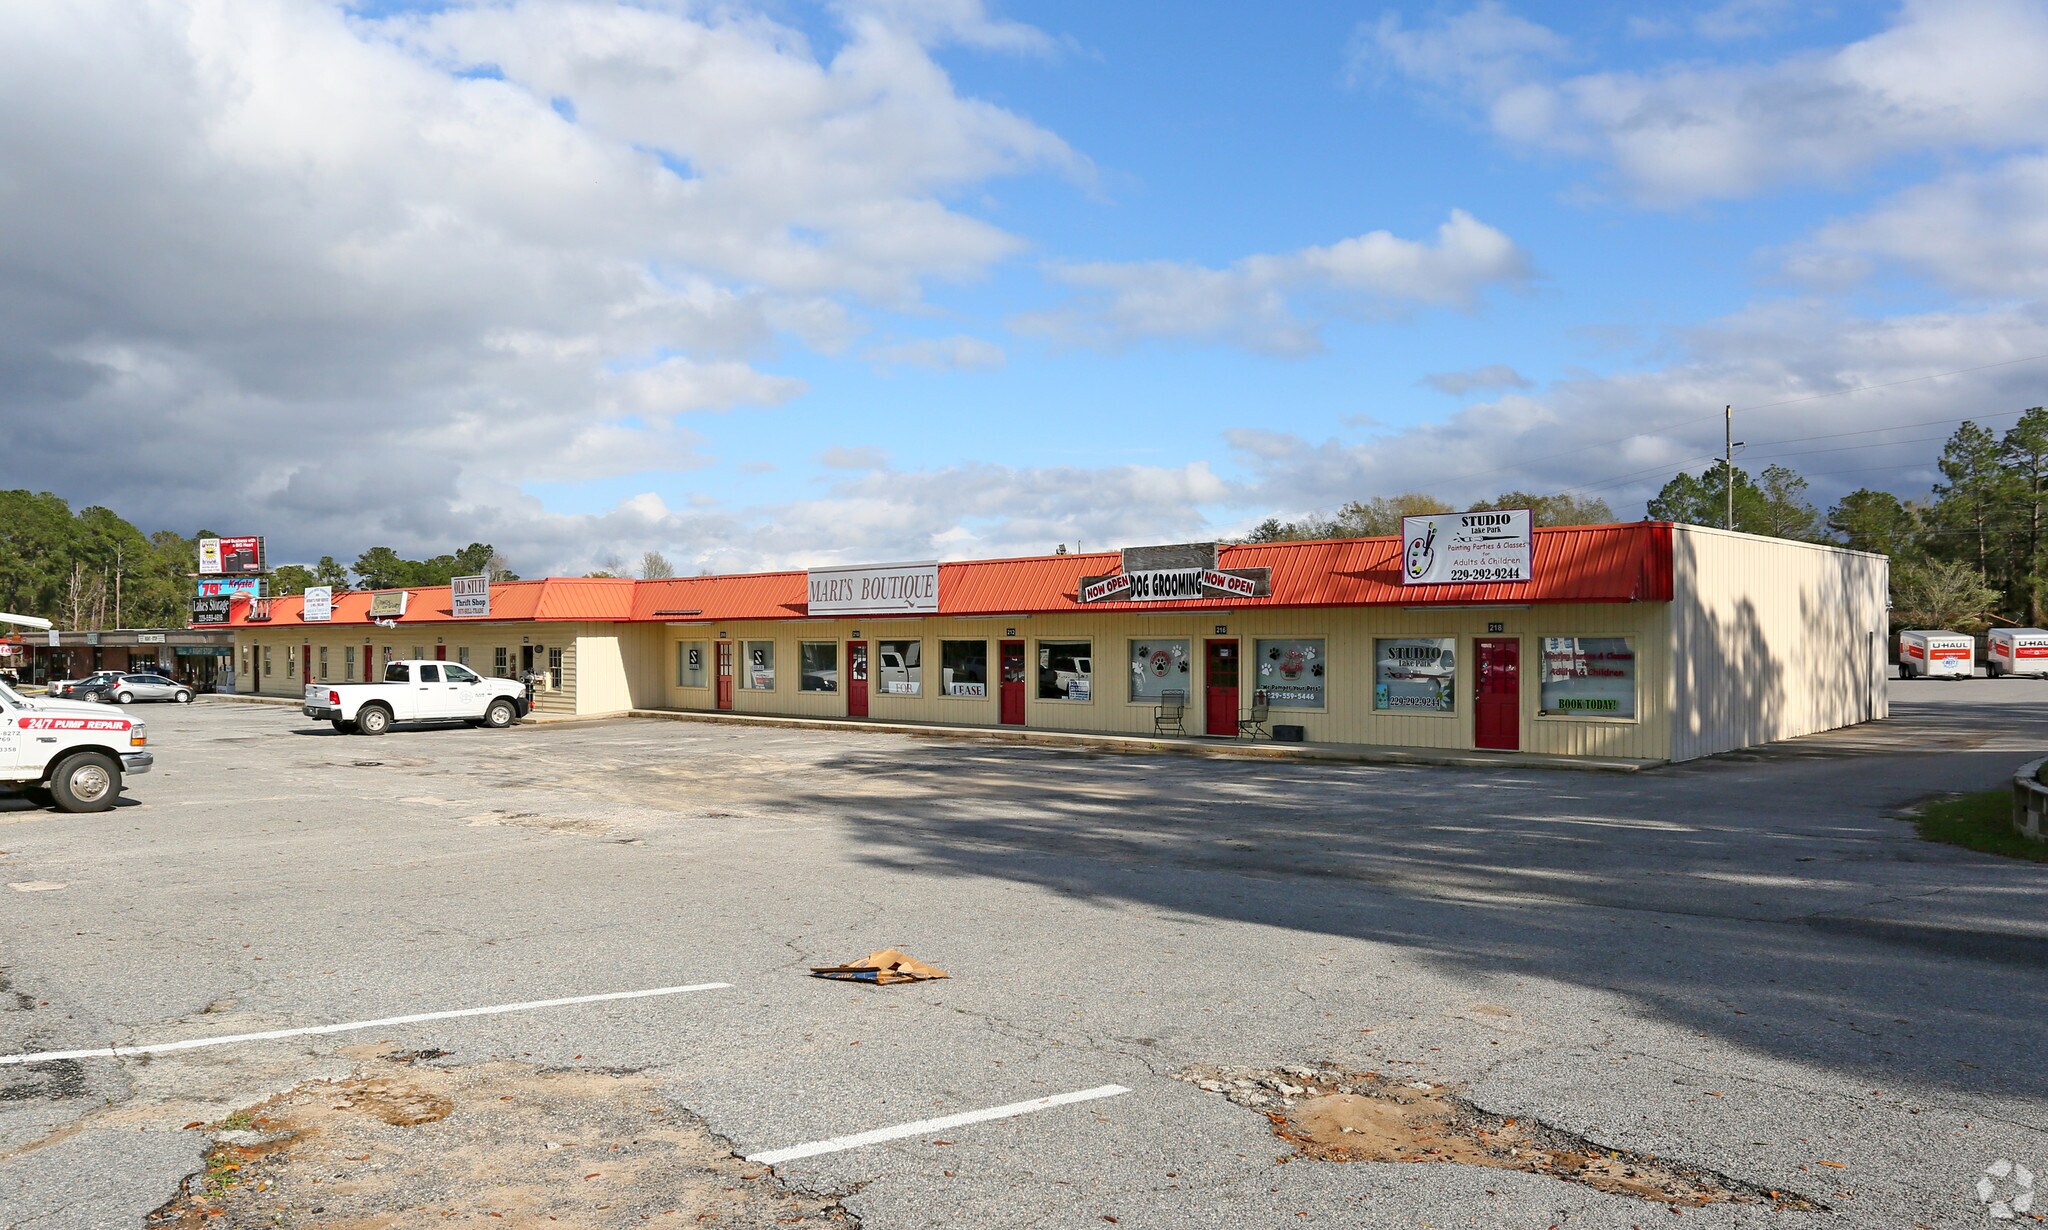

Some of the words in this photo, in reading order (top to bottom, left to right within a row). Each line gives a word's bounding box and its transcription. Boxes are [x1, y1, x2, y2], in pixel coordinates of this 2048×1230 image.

[1462, 514, 1511, 527] STUDIO
[1486, 526, 1502, 534] Park
[1448, 543, 1471, 552] Painting
[1472, 541, 1494, 550] Parties
[1503, 541, 1526, 549] Classes
[1488, 557, 1521, 565] Children
[1450, 568, 1520, 580] 229-292-9244
[229, 580, 255, 590] Krystal
[454, 580, 466, 594] OLD
[468, 579, 486, 593] STUFF
[1087, 586, 1105, 599] NOW
[1106, 575, 1130, 592] OPEN
[1130, 573, 1149, 597] DOG
[1152, 571, 1202, 596] GROOMING
[1204, 573, 1226, 590] NOW
[1228, 581, 1253, 594] OPEN
[808, 578, 853, 602] MARI'S
[861, 574, 934, 607] BOUTIQUE
[194, 600, 208, 612] Lakes
[210, 600, 230, 614] Storage
[472, 598, 486, 607] Shop
[1388, 647, 1441, 660] STUDIO
[1588, 668, 1624, 676] Children
[896, 683, 912, 693] FOR
[1390, 696, 1440, 706] 229-292-9244
[1559, 700, 1582, 709] BOOK
[1584, 700, 1616, 710] TODAY!
[27, 718, 53, 729] 24/7
[54, 720, 84, 728] PUMP
[86, 721, 124, 729] REPAIR
